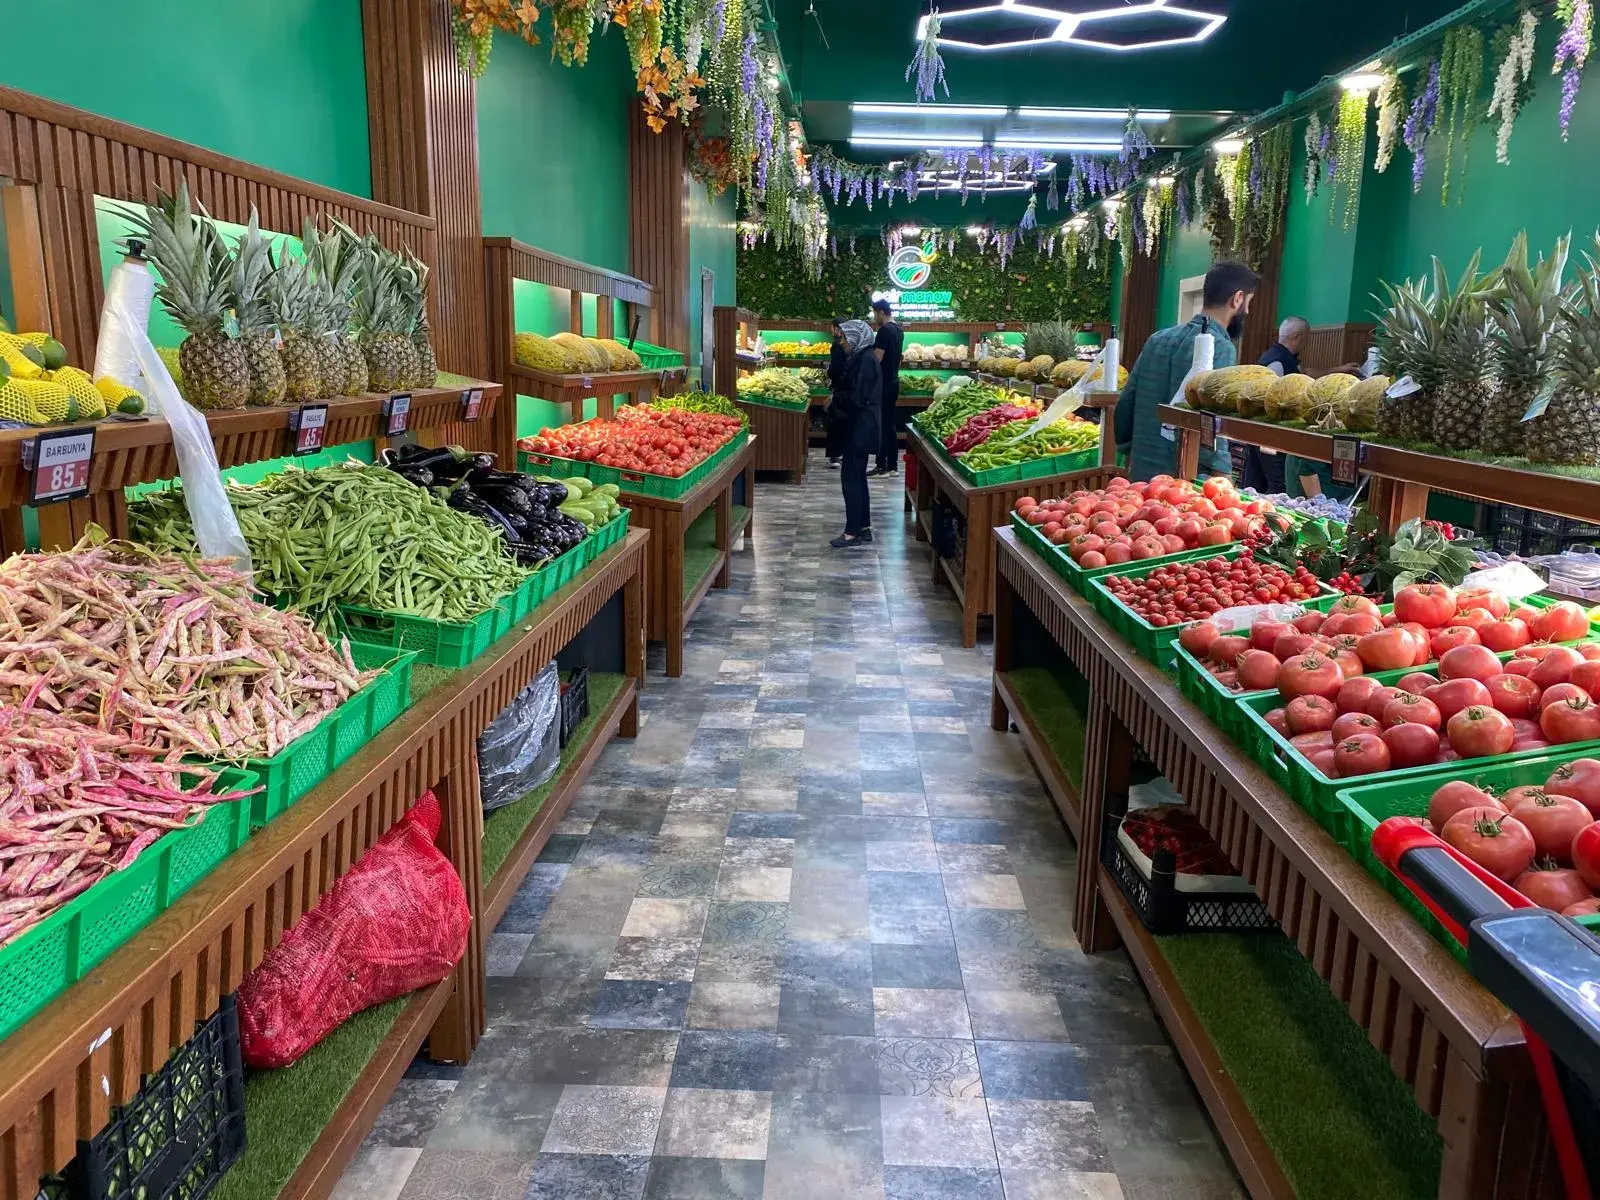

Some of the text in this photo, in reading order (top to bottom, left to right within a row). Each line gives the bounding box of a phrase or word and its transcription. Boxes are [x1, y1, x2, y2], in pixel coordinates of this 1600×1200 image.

[305, 428, 317, 446] 65
[45, 443, 86, 458] BARBUNYA
[51, 463, 75, 490] 85
